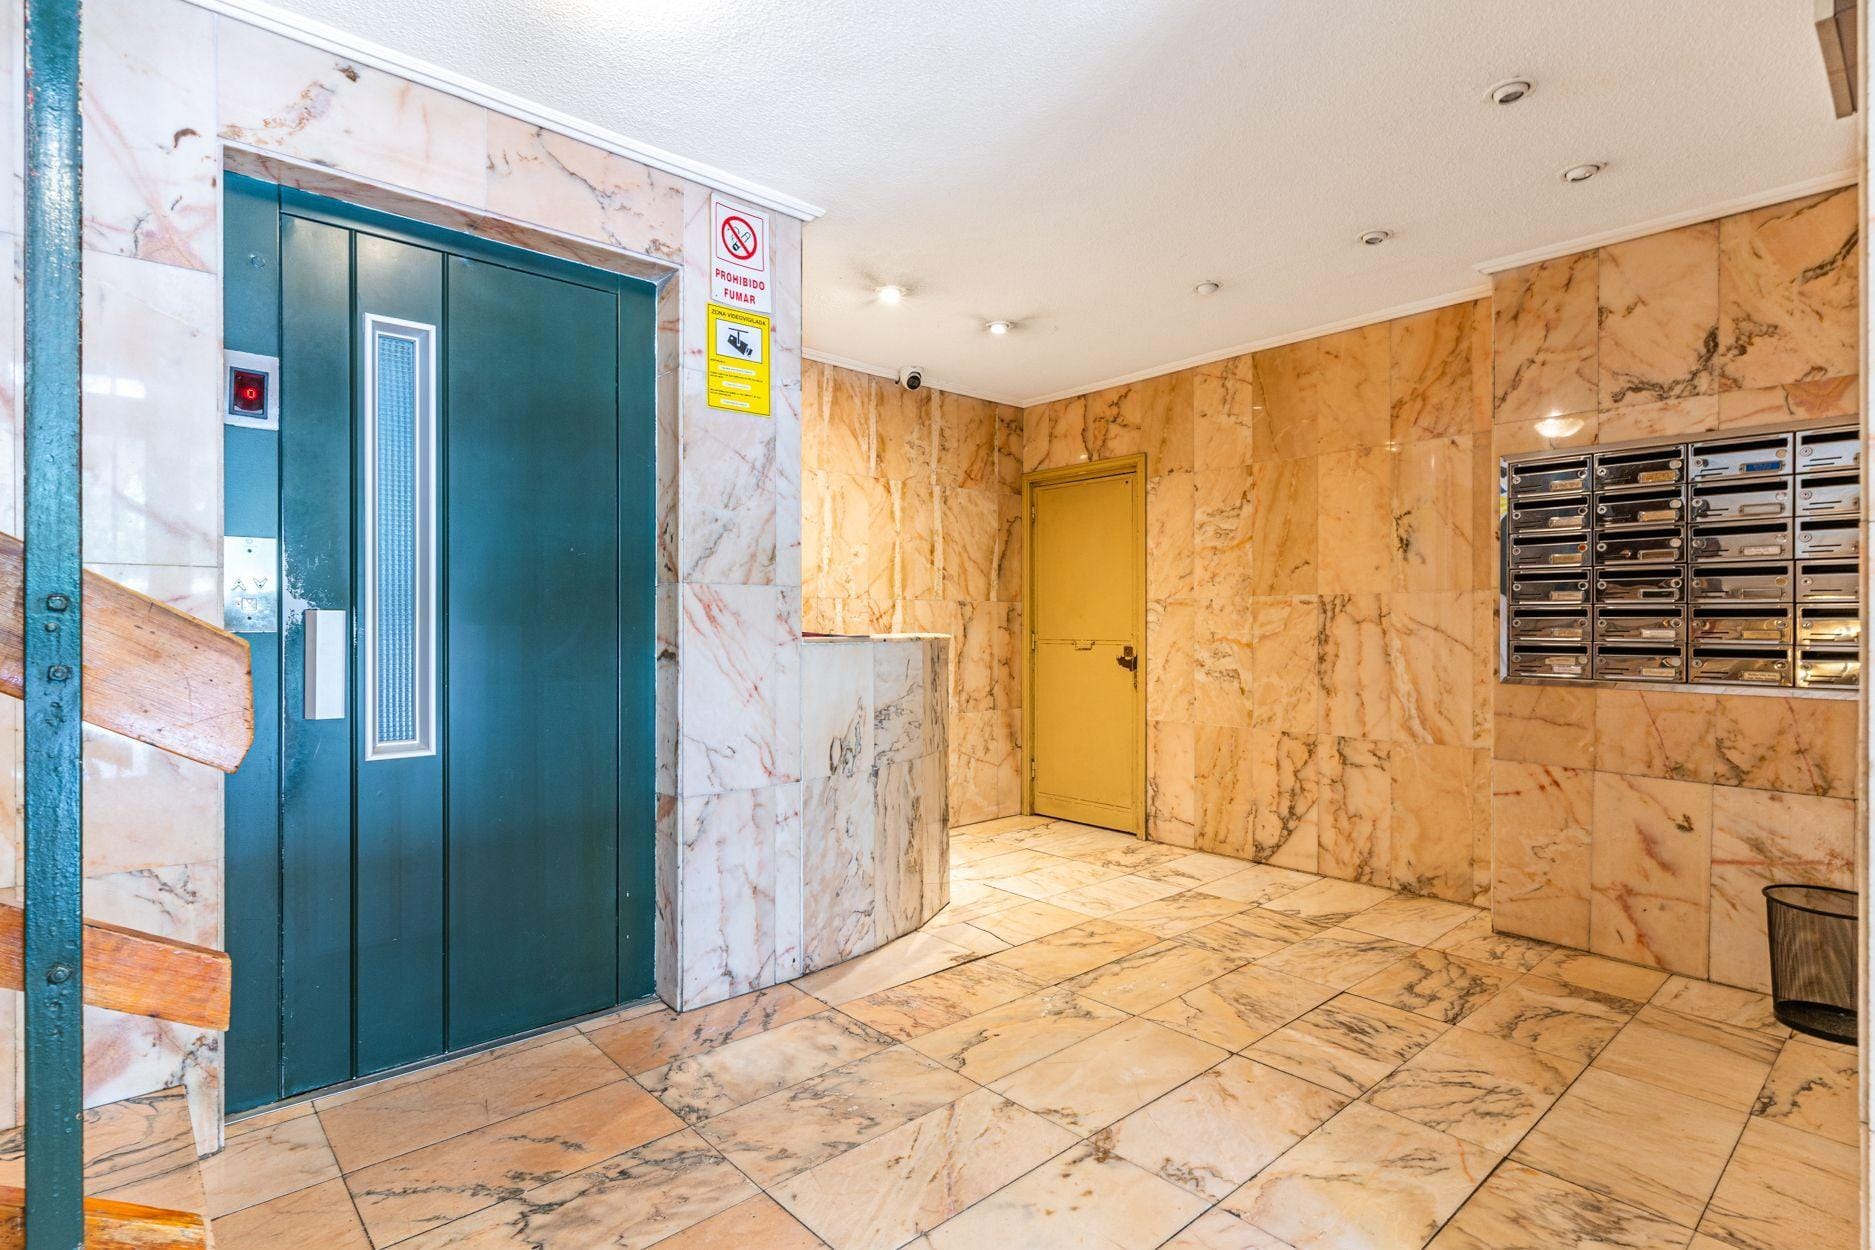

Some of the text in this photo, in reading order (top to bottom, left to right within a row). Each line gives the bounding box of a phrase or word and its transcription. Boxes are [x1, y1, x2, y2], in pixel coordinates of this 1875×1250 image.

[715, 268, 765, 291] PROHIBIDO
[724, 288, 756, 305] FUMAR
[711, 309, 766, 326] ZONA VIDEOVIGILADA
